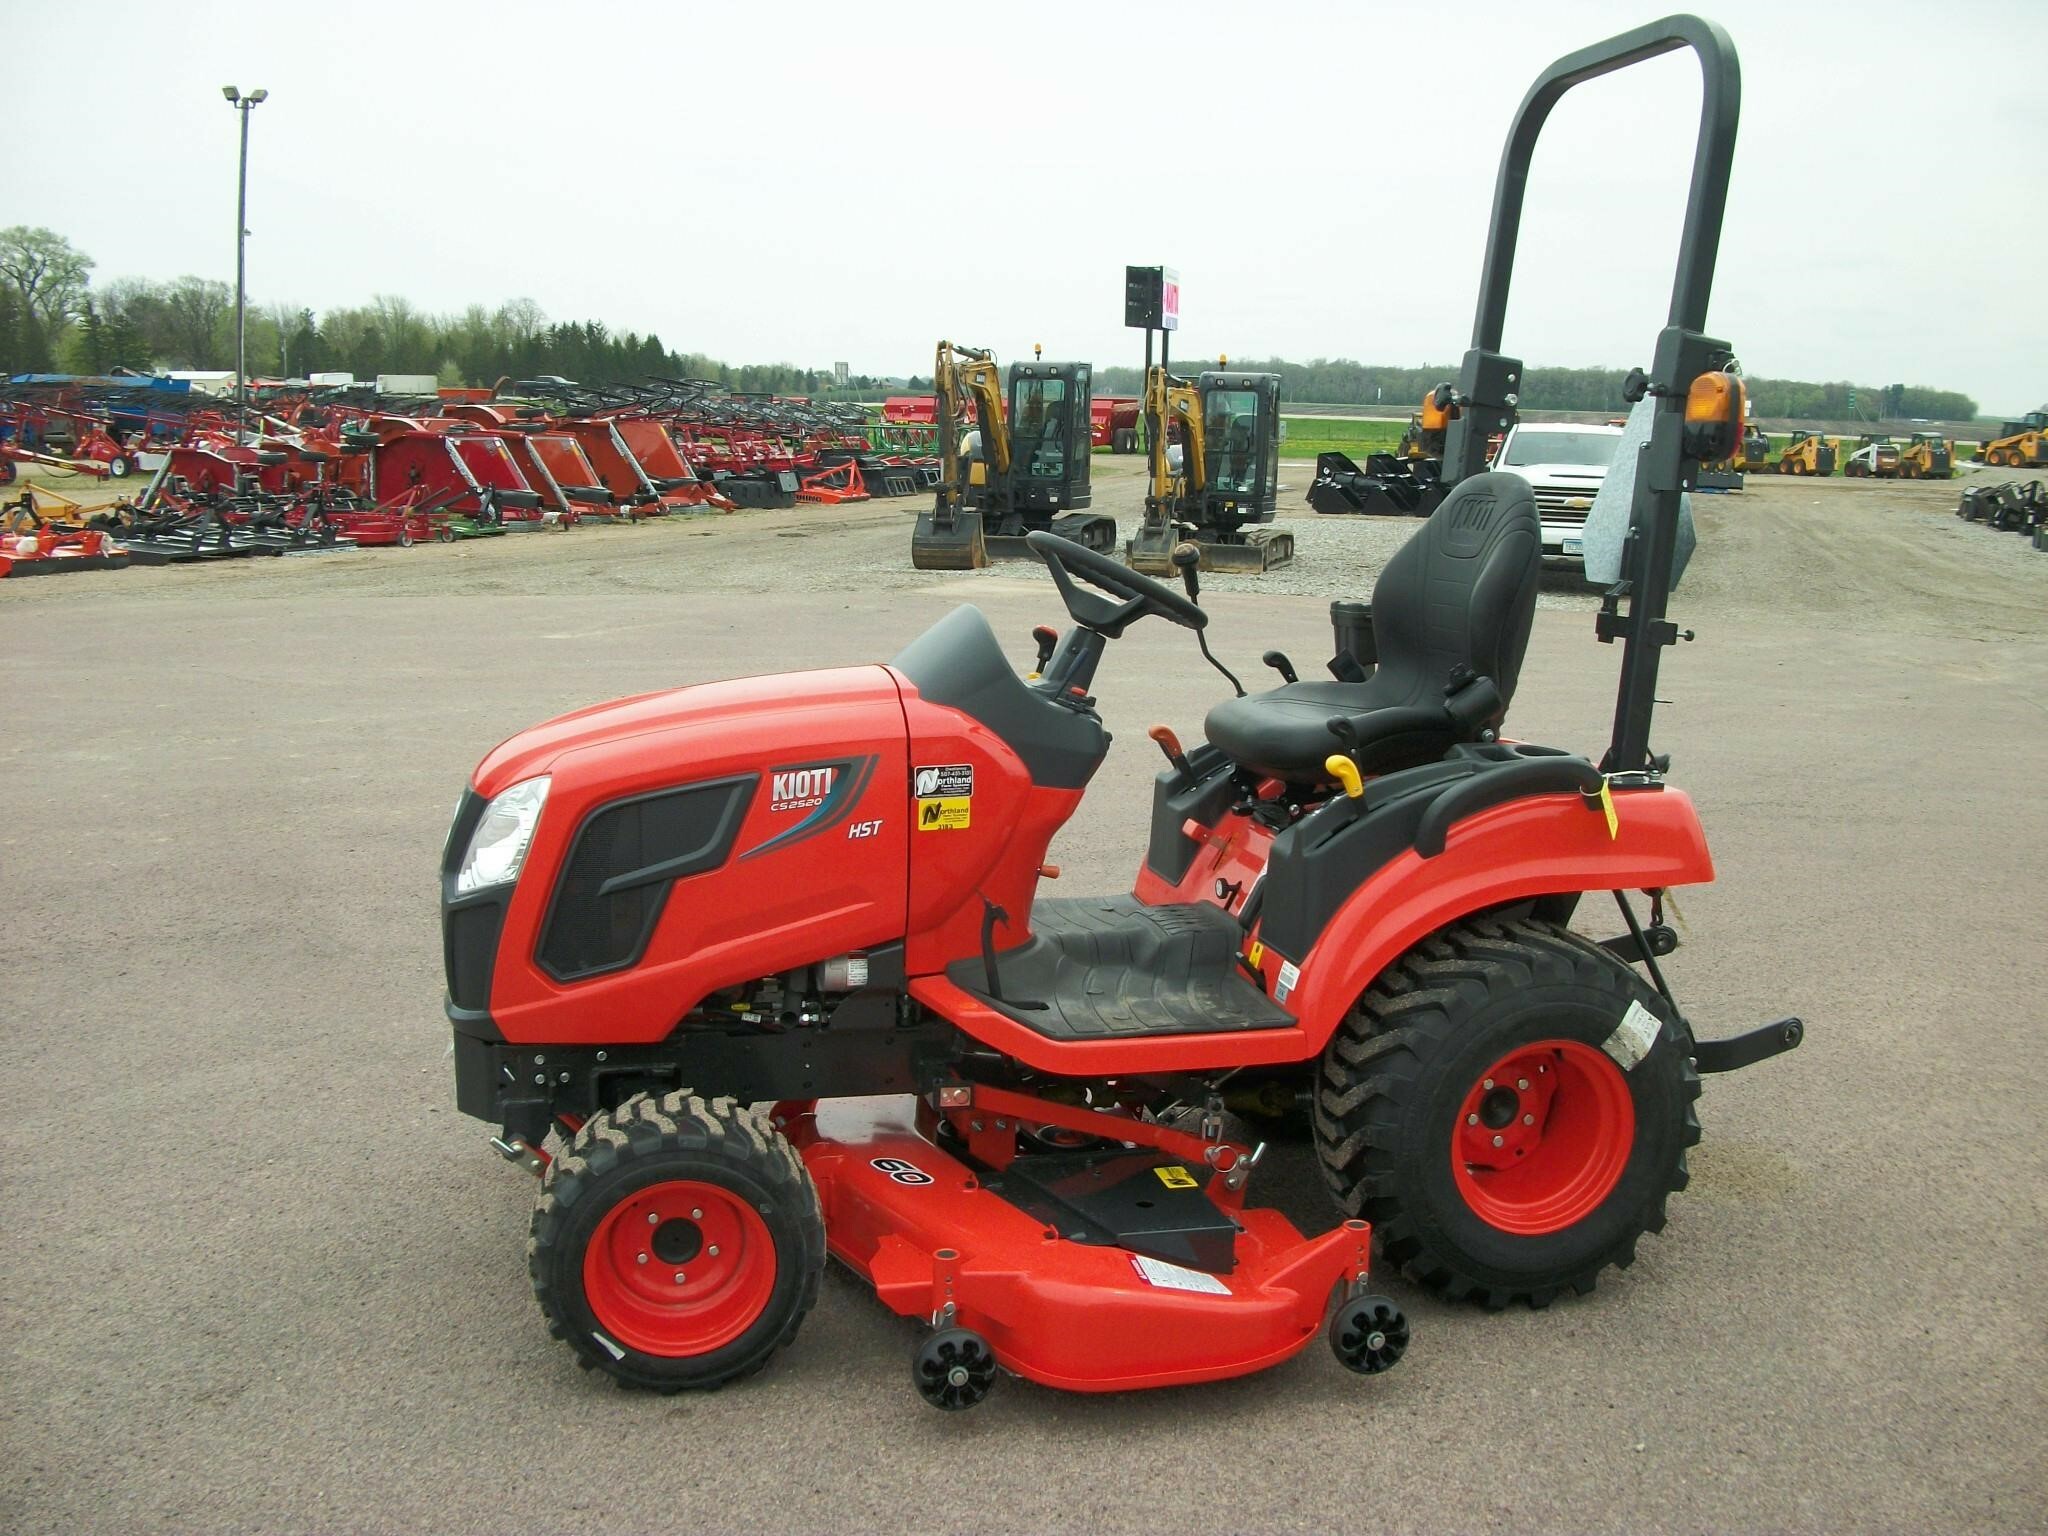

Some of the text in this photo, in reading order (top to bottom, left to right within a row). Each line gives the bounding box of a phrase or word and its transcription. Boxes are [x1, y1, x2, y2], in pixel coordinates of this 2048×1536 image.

[772, 768, 832, 801] KIOTI
[770, 798, 823, 811] CS2520
[848, 820, 883, 839] HST
